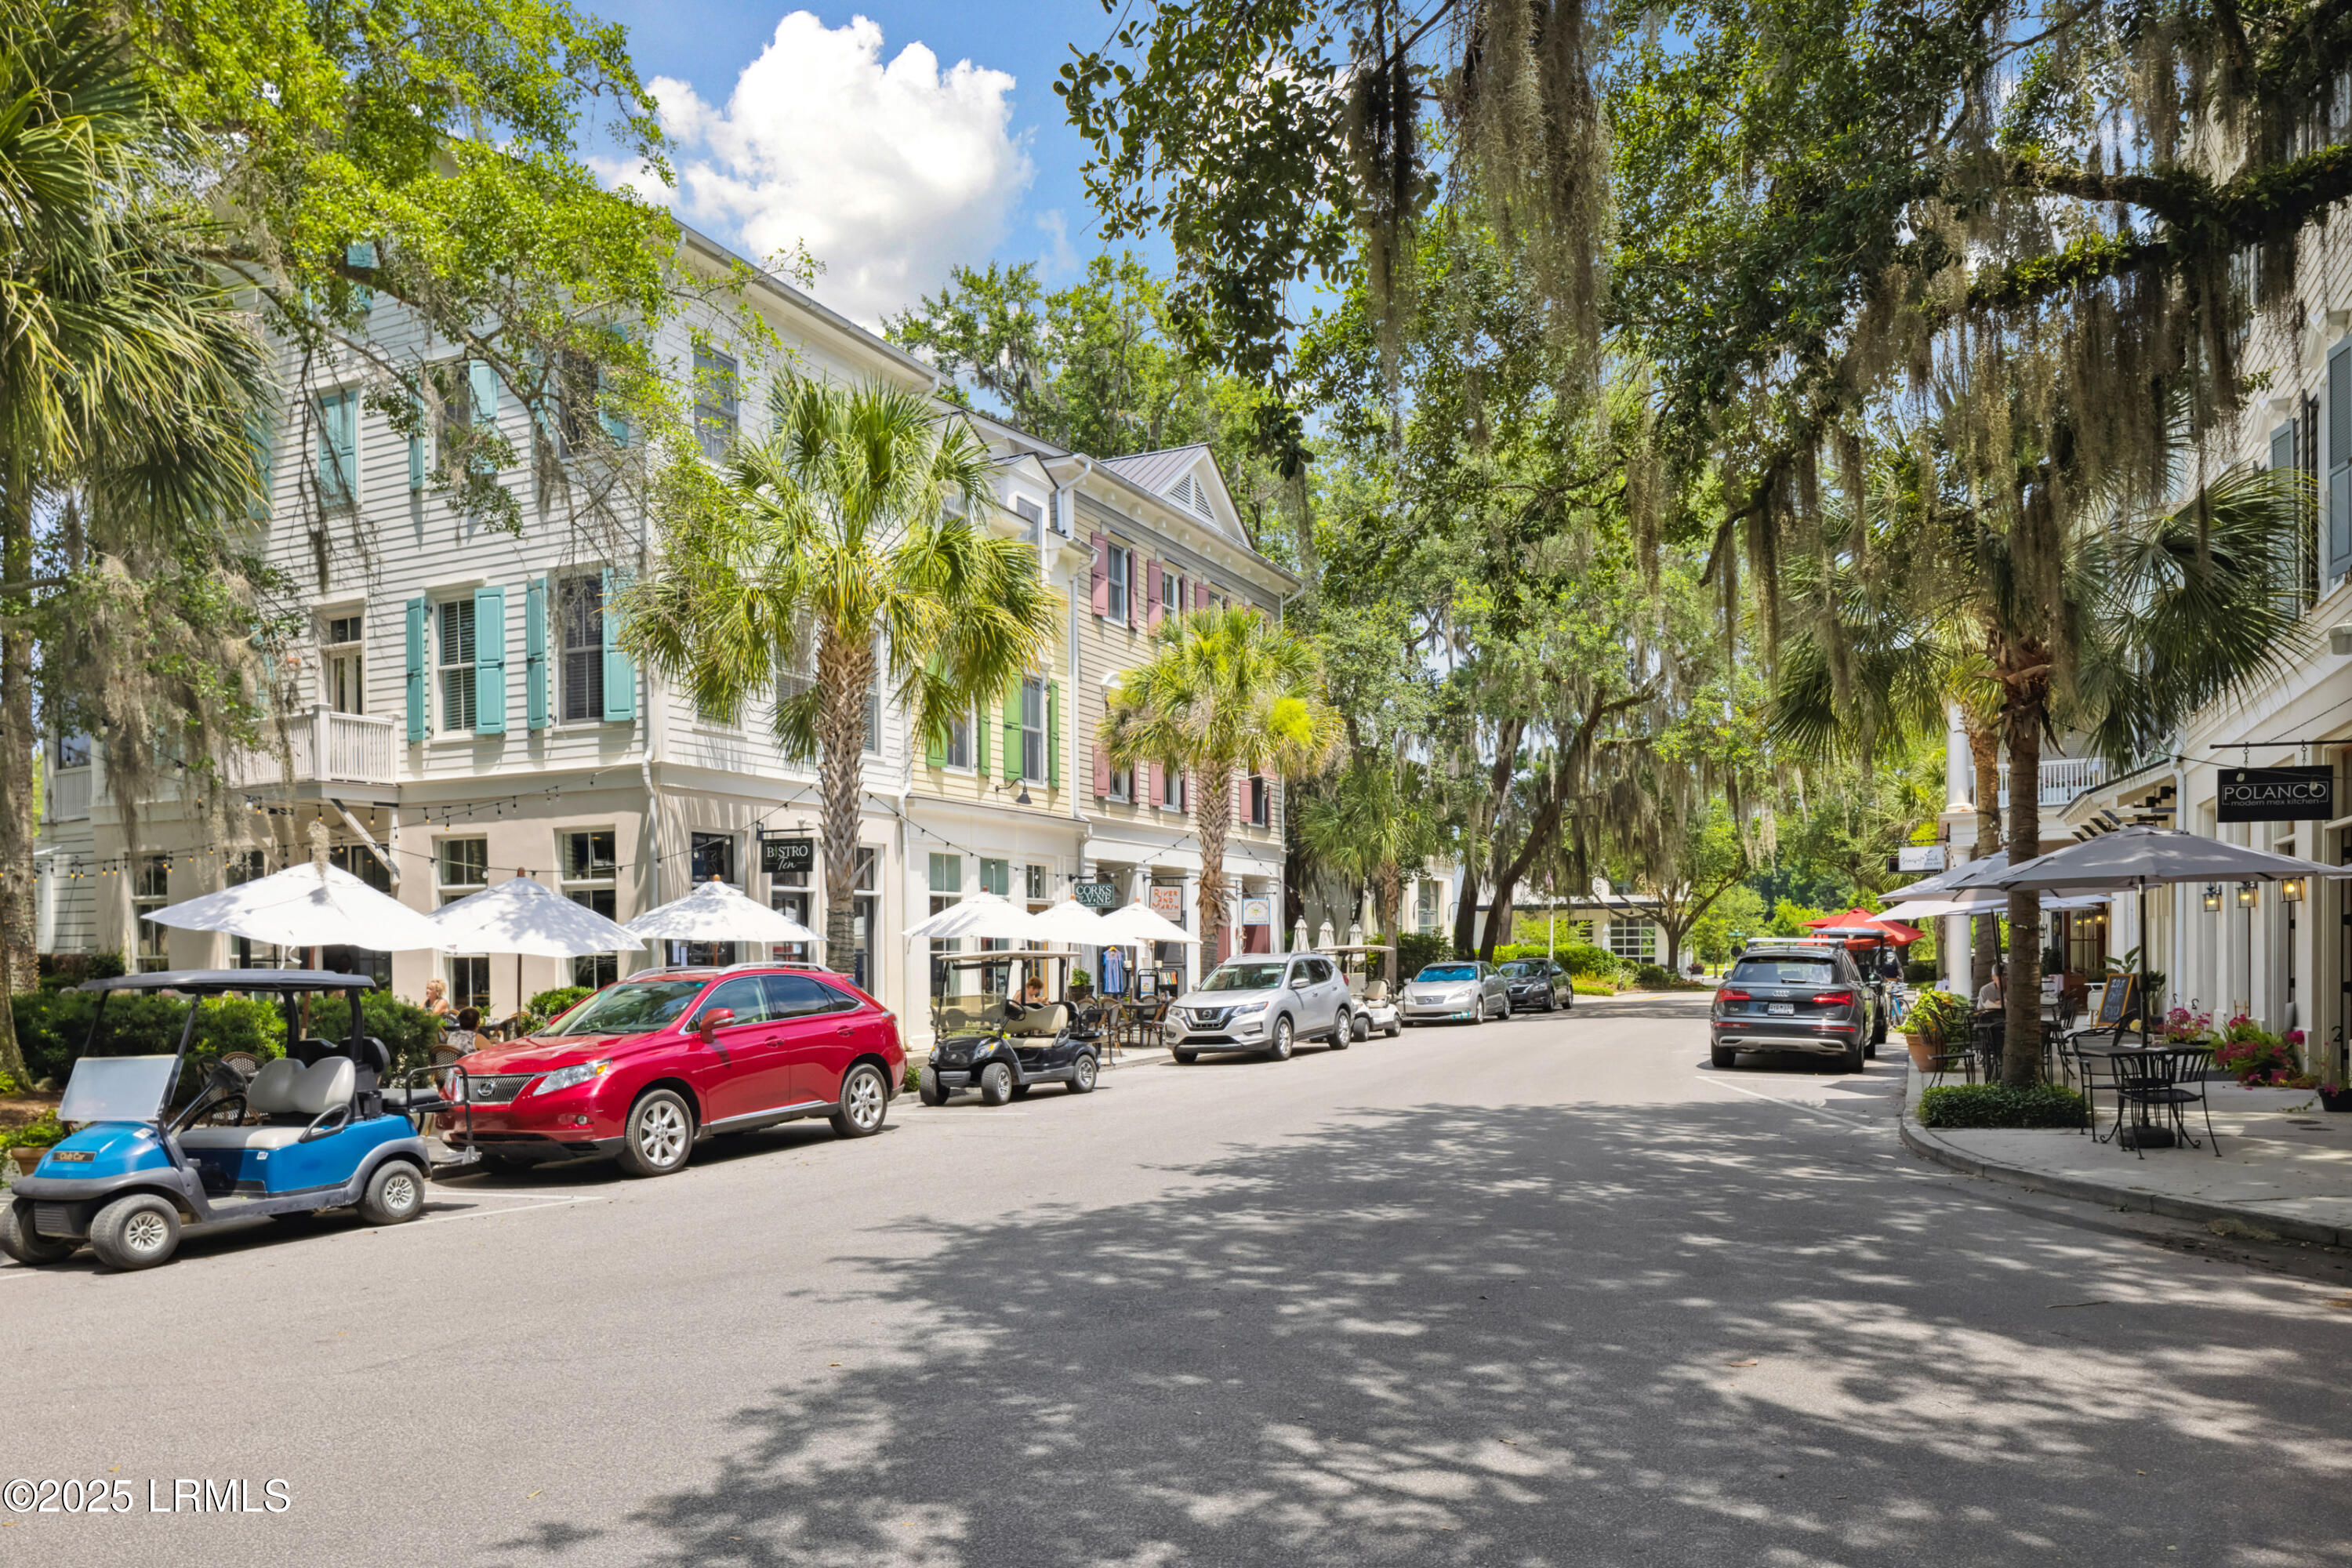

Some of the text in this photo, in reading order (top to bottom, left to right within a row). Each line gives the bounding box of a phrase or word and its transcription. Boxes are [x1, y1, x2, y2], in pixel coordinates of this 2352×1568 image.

[2224, 784, 2326, 800] POLANCO
[767, 845, 808, 858] BISTRO
[778, 856, 797, 871] Ten
[1076, 885, 1112, 895] CORKS
